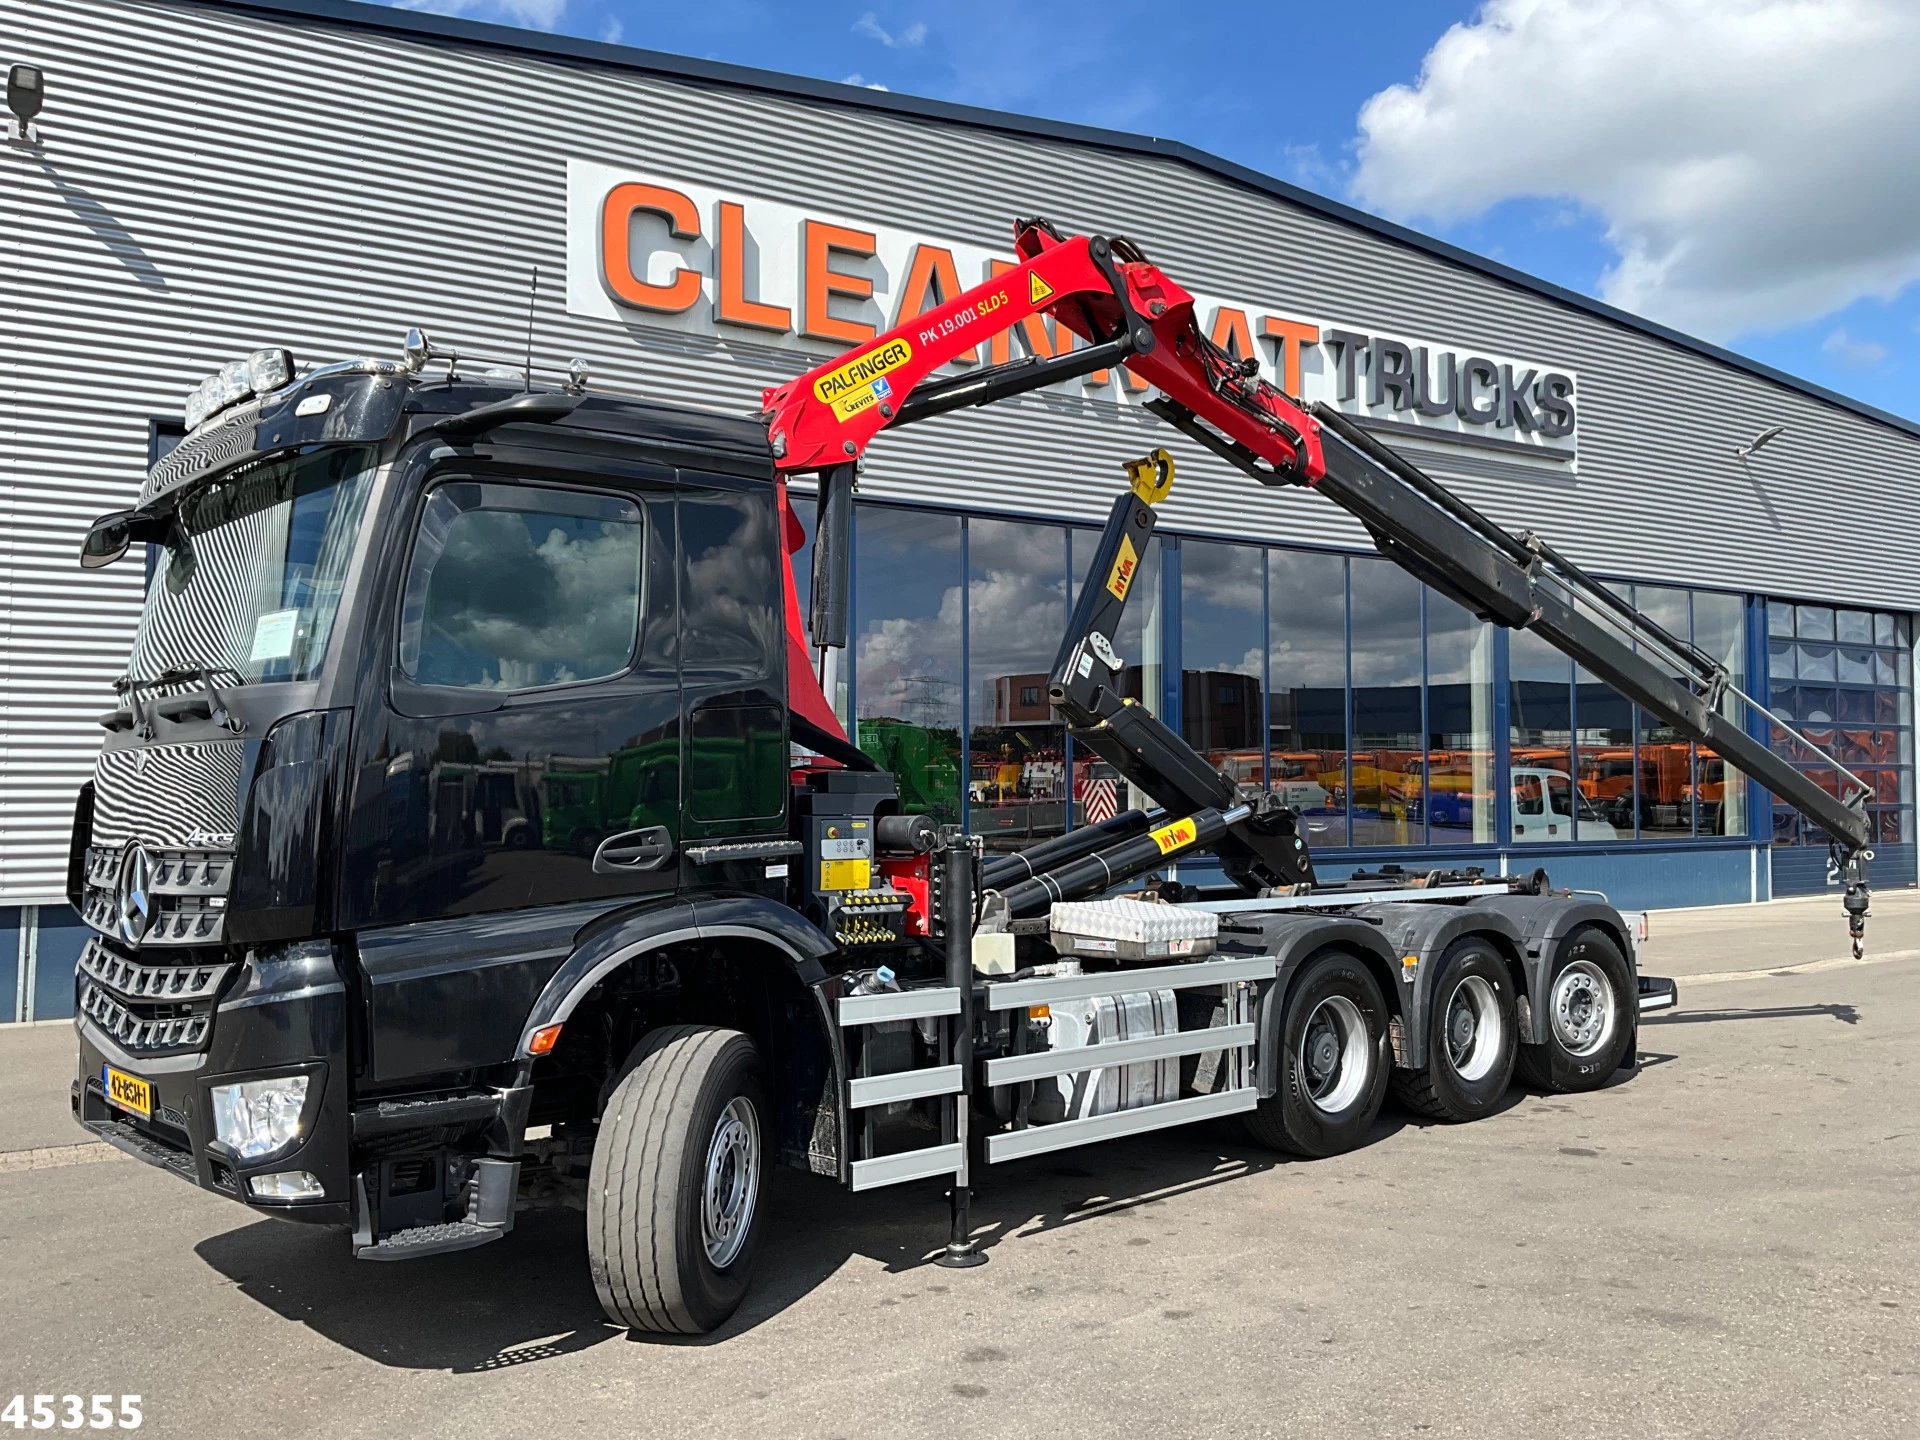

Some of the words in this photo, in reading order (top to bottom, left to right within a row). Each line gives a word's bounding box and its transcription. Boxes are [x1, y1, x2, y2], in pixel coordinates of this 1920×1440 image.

[599, 181, 1320, 400] CLEANAT
[1324, 328, 1576, 438] TRUCKS
[918, 328, 941, 347] PK
[940, 307, 978, 336] 19.001
[977, 290, 1009, 317] SLD5
[819, 343, 907, 399] PALFINGER
[1114, 559, 1133, 595] HYVA
[1160, 829, 1190, 849] HYVA
[1170, 939, 1190, 952] HYVA
